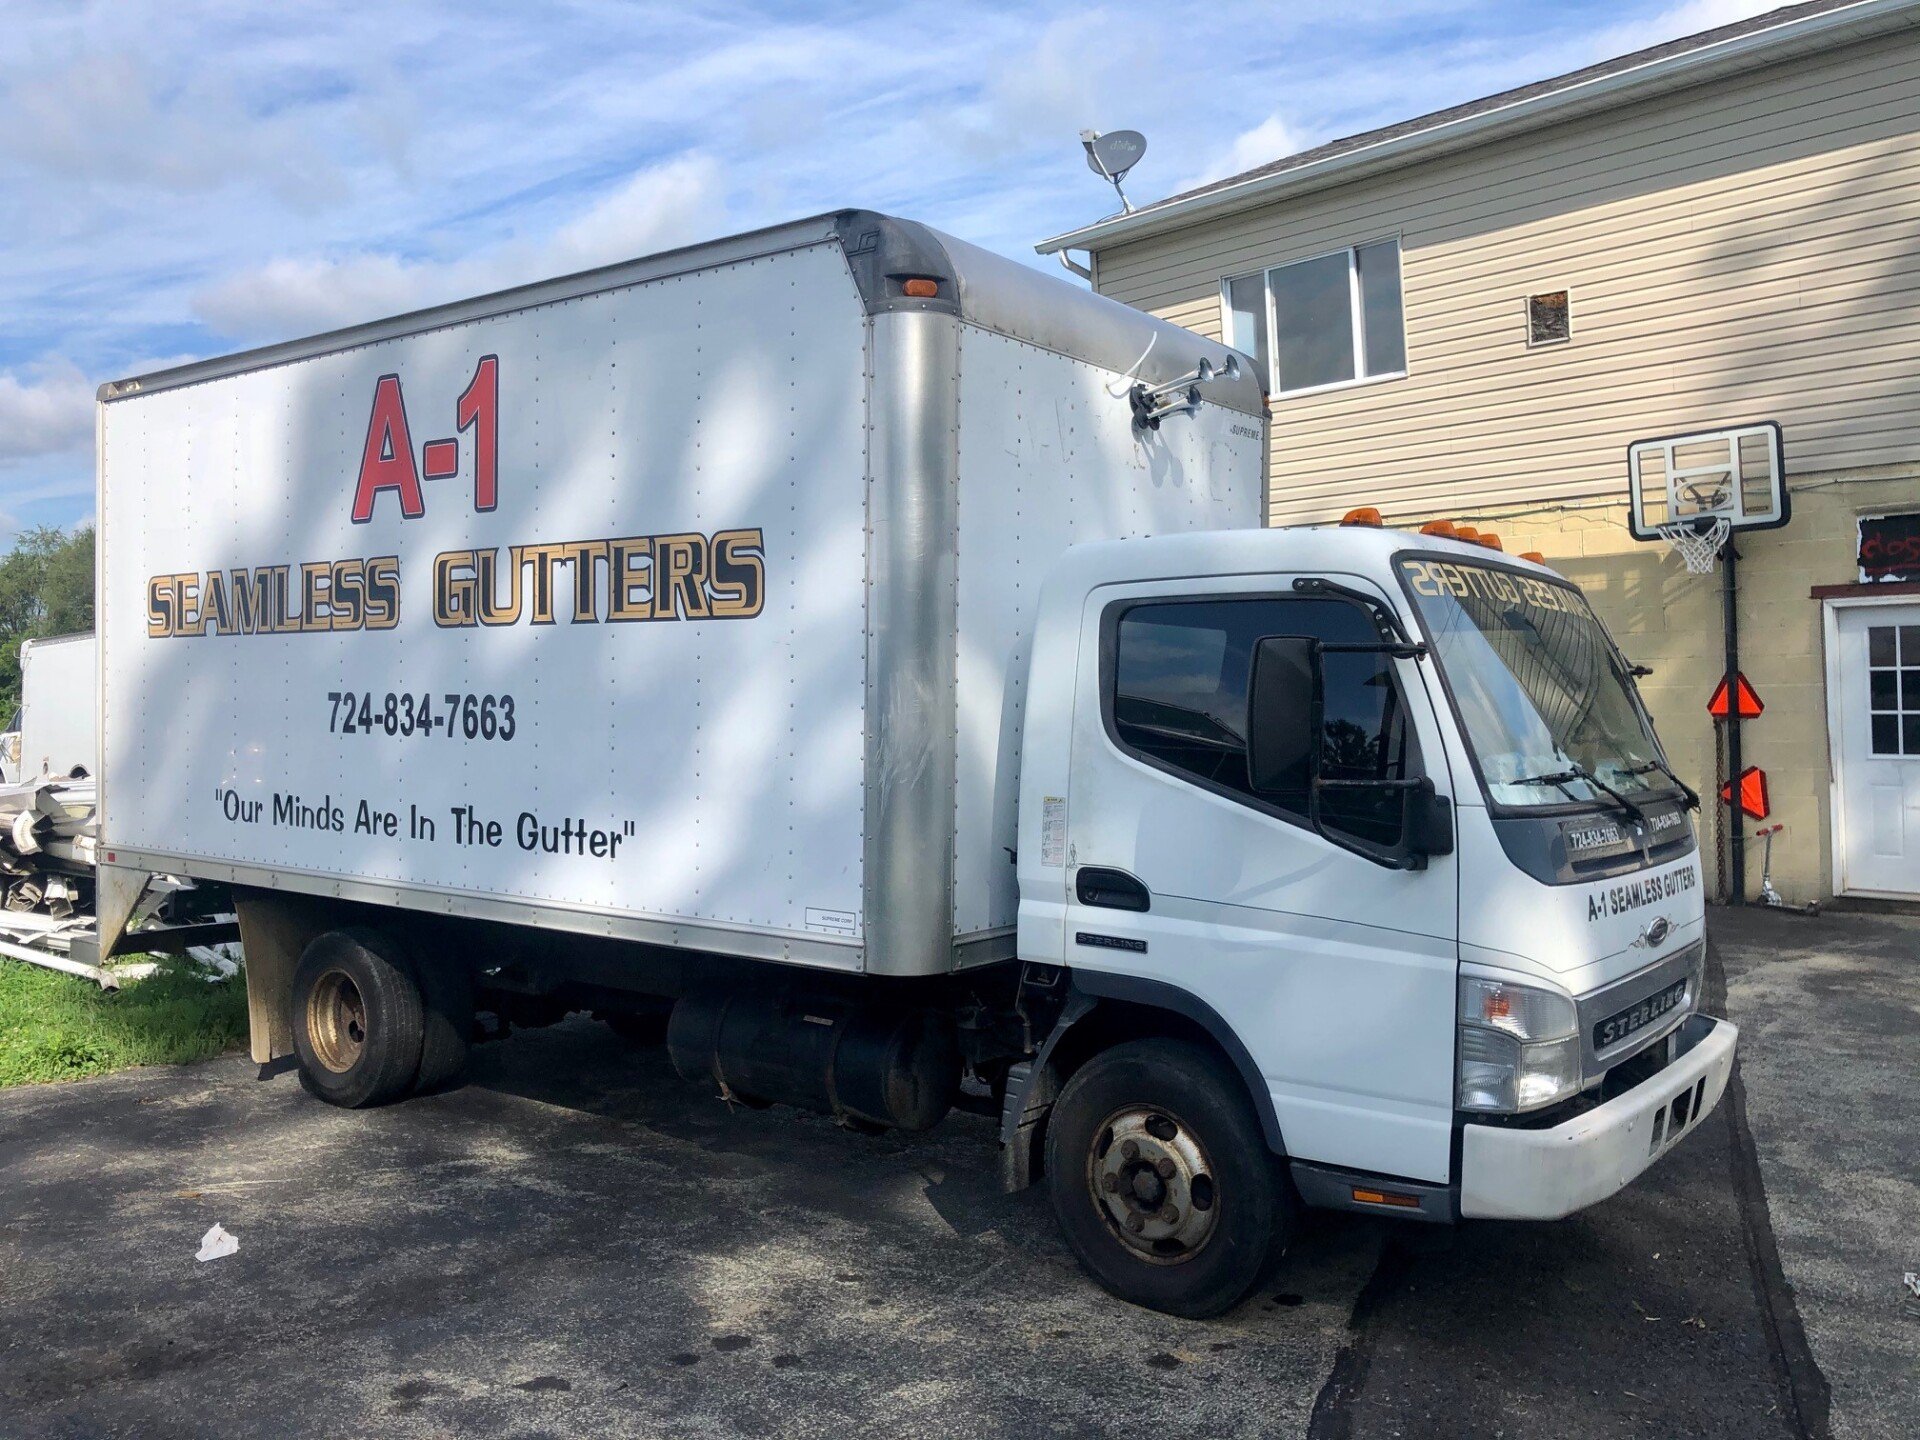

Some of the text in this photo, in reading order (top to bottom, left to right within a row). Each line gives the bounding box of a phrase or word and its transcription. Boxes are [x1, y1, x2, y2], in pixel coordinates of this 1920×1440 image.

[350, 354, 499, 524] A-1
[147, 527, 766, 639] SEAMLESS GUTTERS
[327, 692, 516, 742] 724-834-7663
[215, 788, 635, 859] "Our Minds Are In The Gutter"
[1588, 864, 1696, 922] A-1 SEAMLESS GUTTERS
[1077, 934, 1144, 950] STERLING
[1603, 984, 1684, 1045] STERLING
